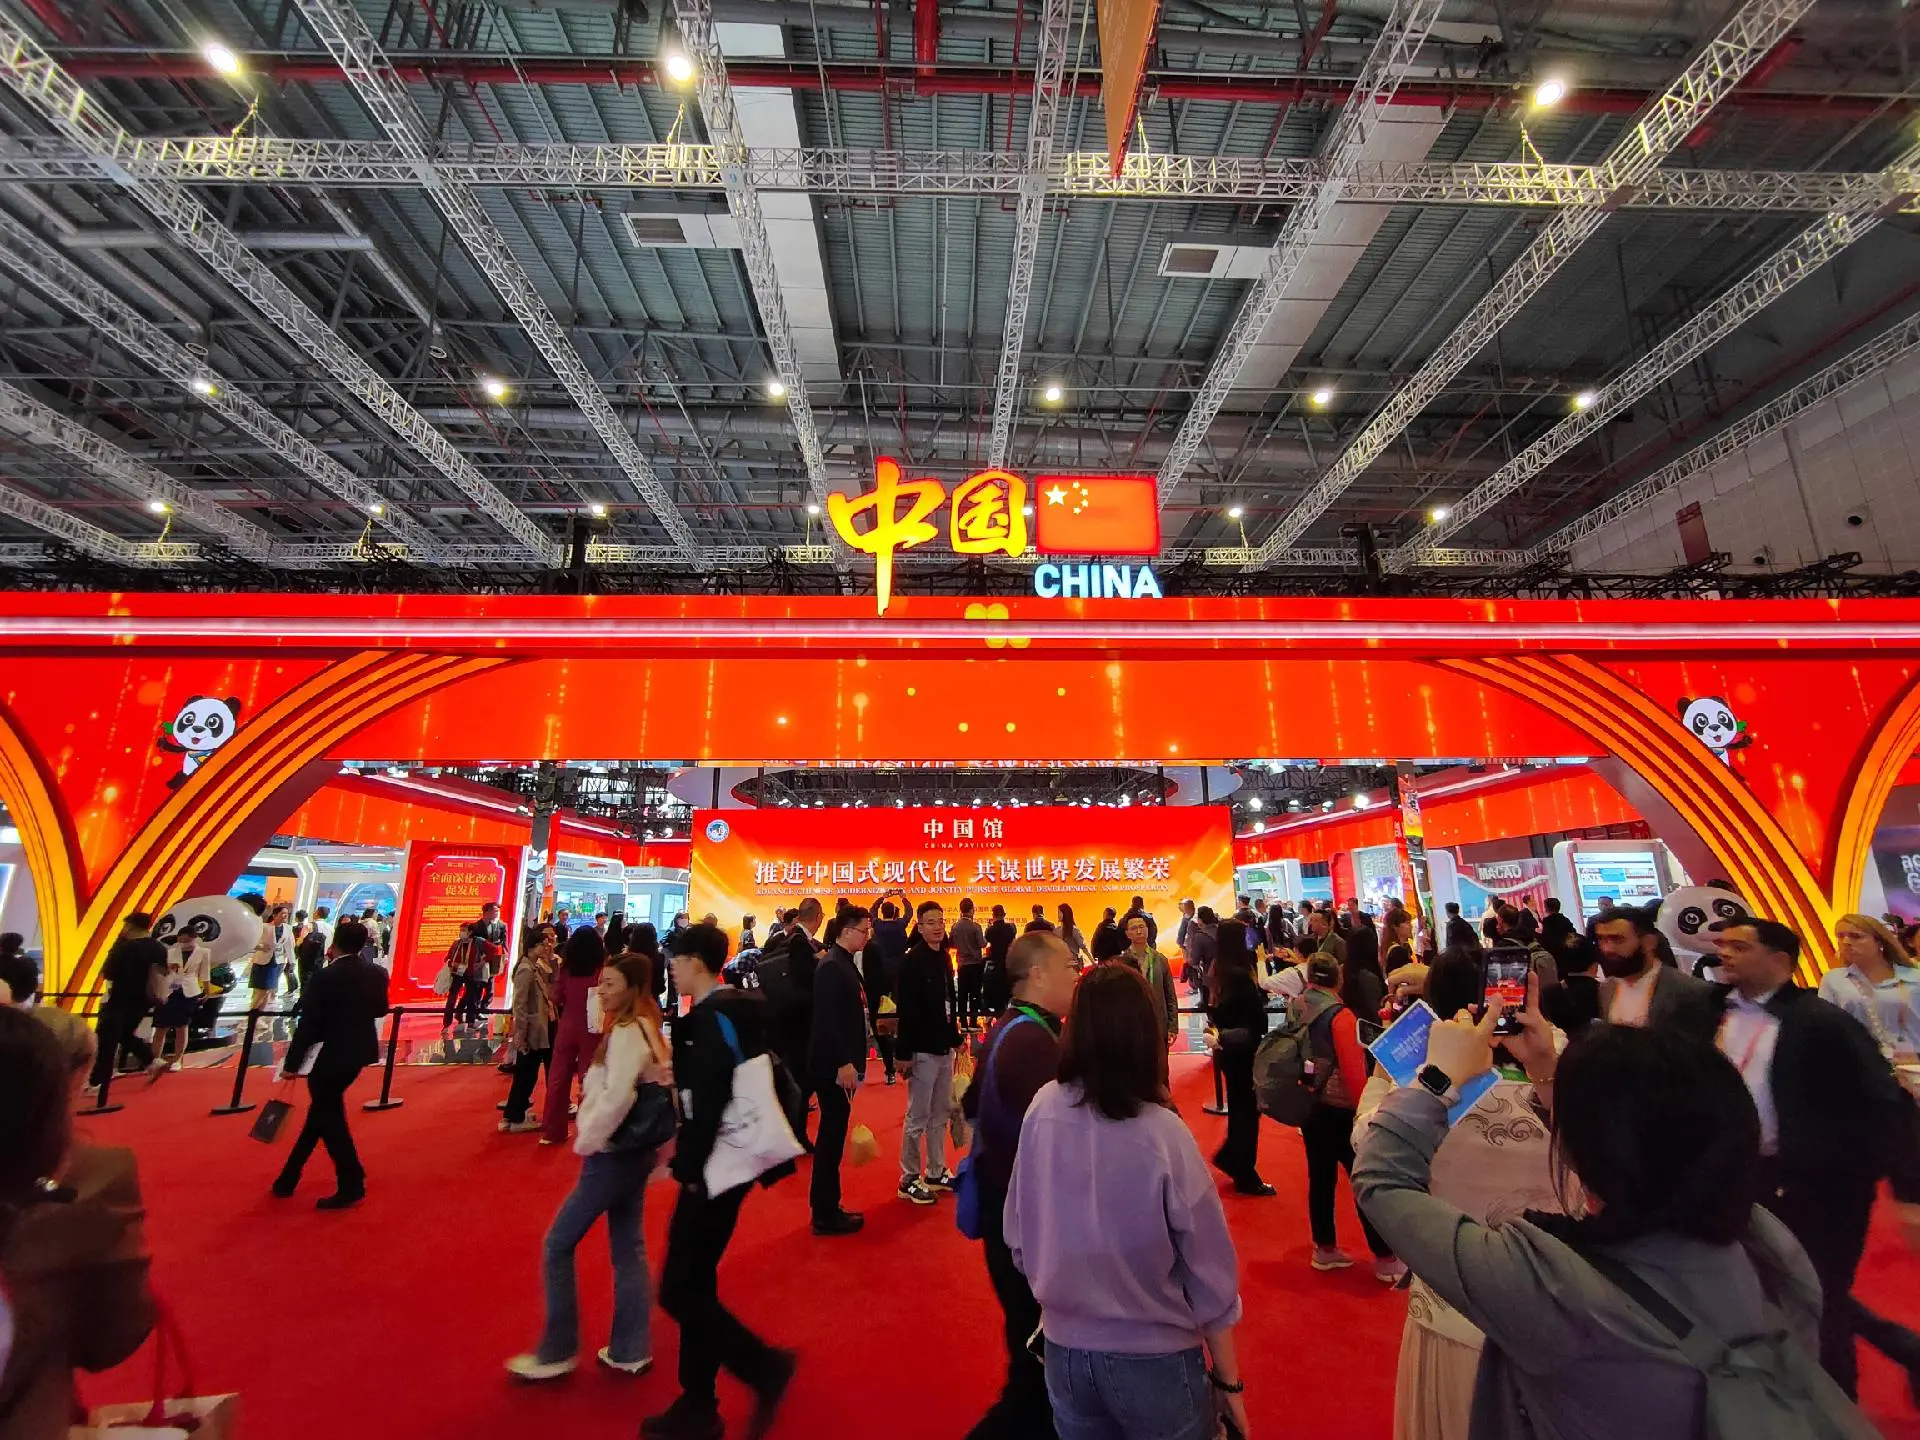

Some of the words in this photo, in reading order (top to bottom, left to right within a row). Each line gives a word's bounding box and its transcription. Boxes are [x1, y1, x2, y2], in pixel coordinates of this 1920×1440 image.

[826, 456, 1028, 617] 中国
[1034, 563, 1163, 599] CHINA
[923, 818, 1004, 839] 中国馆
[755, 860, 956, 885] 推进中国式现代化
[974, 856, 1170, 882] 共谋世界发展繁荣
[1478, 863, 1522, 880] MACAO
